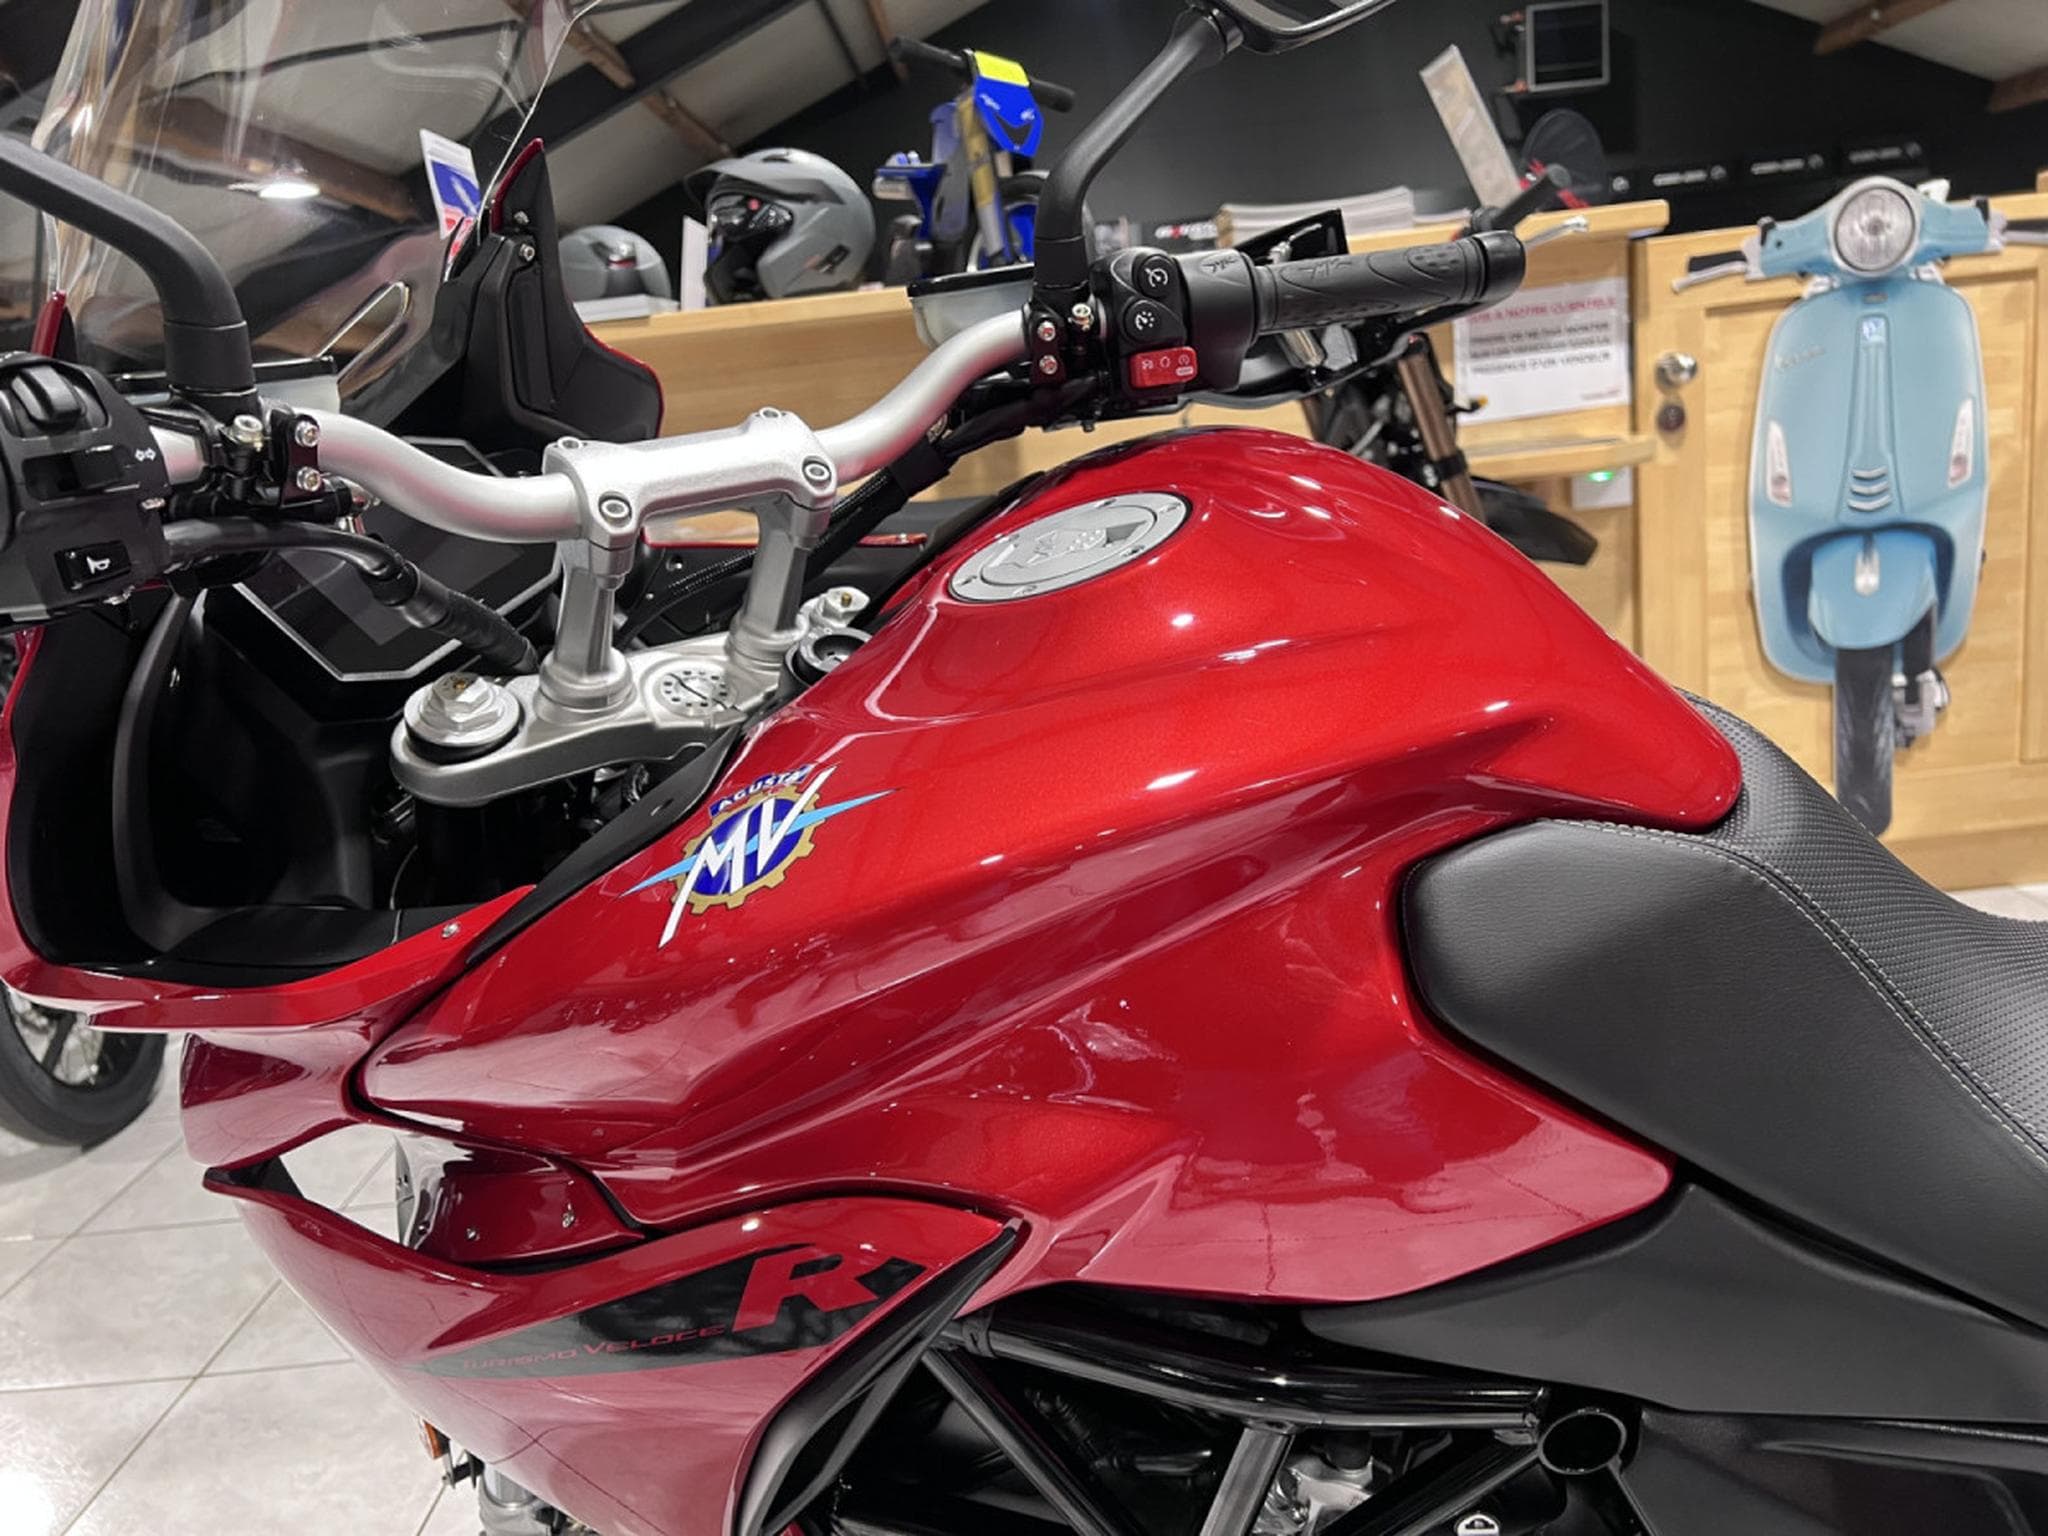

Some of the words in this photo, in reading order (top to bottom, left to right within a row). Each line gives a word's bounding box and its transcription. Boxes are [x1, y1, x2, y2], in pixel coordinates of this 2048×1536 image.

[718, 768, 808, 812] AGUSTA
[658, 765, 837, 949] MV
[582, 1323, 725, 1355] VELOCE
[732, 1246, 878, 1333] R
